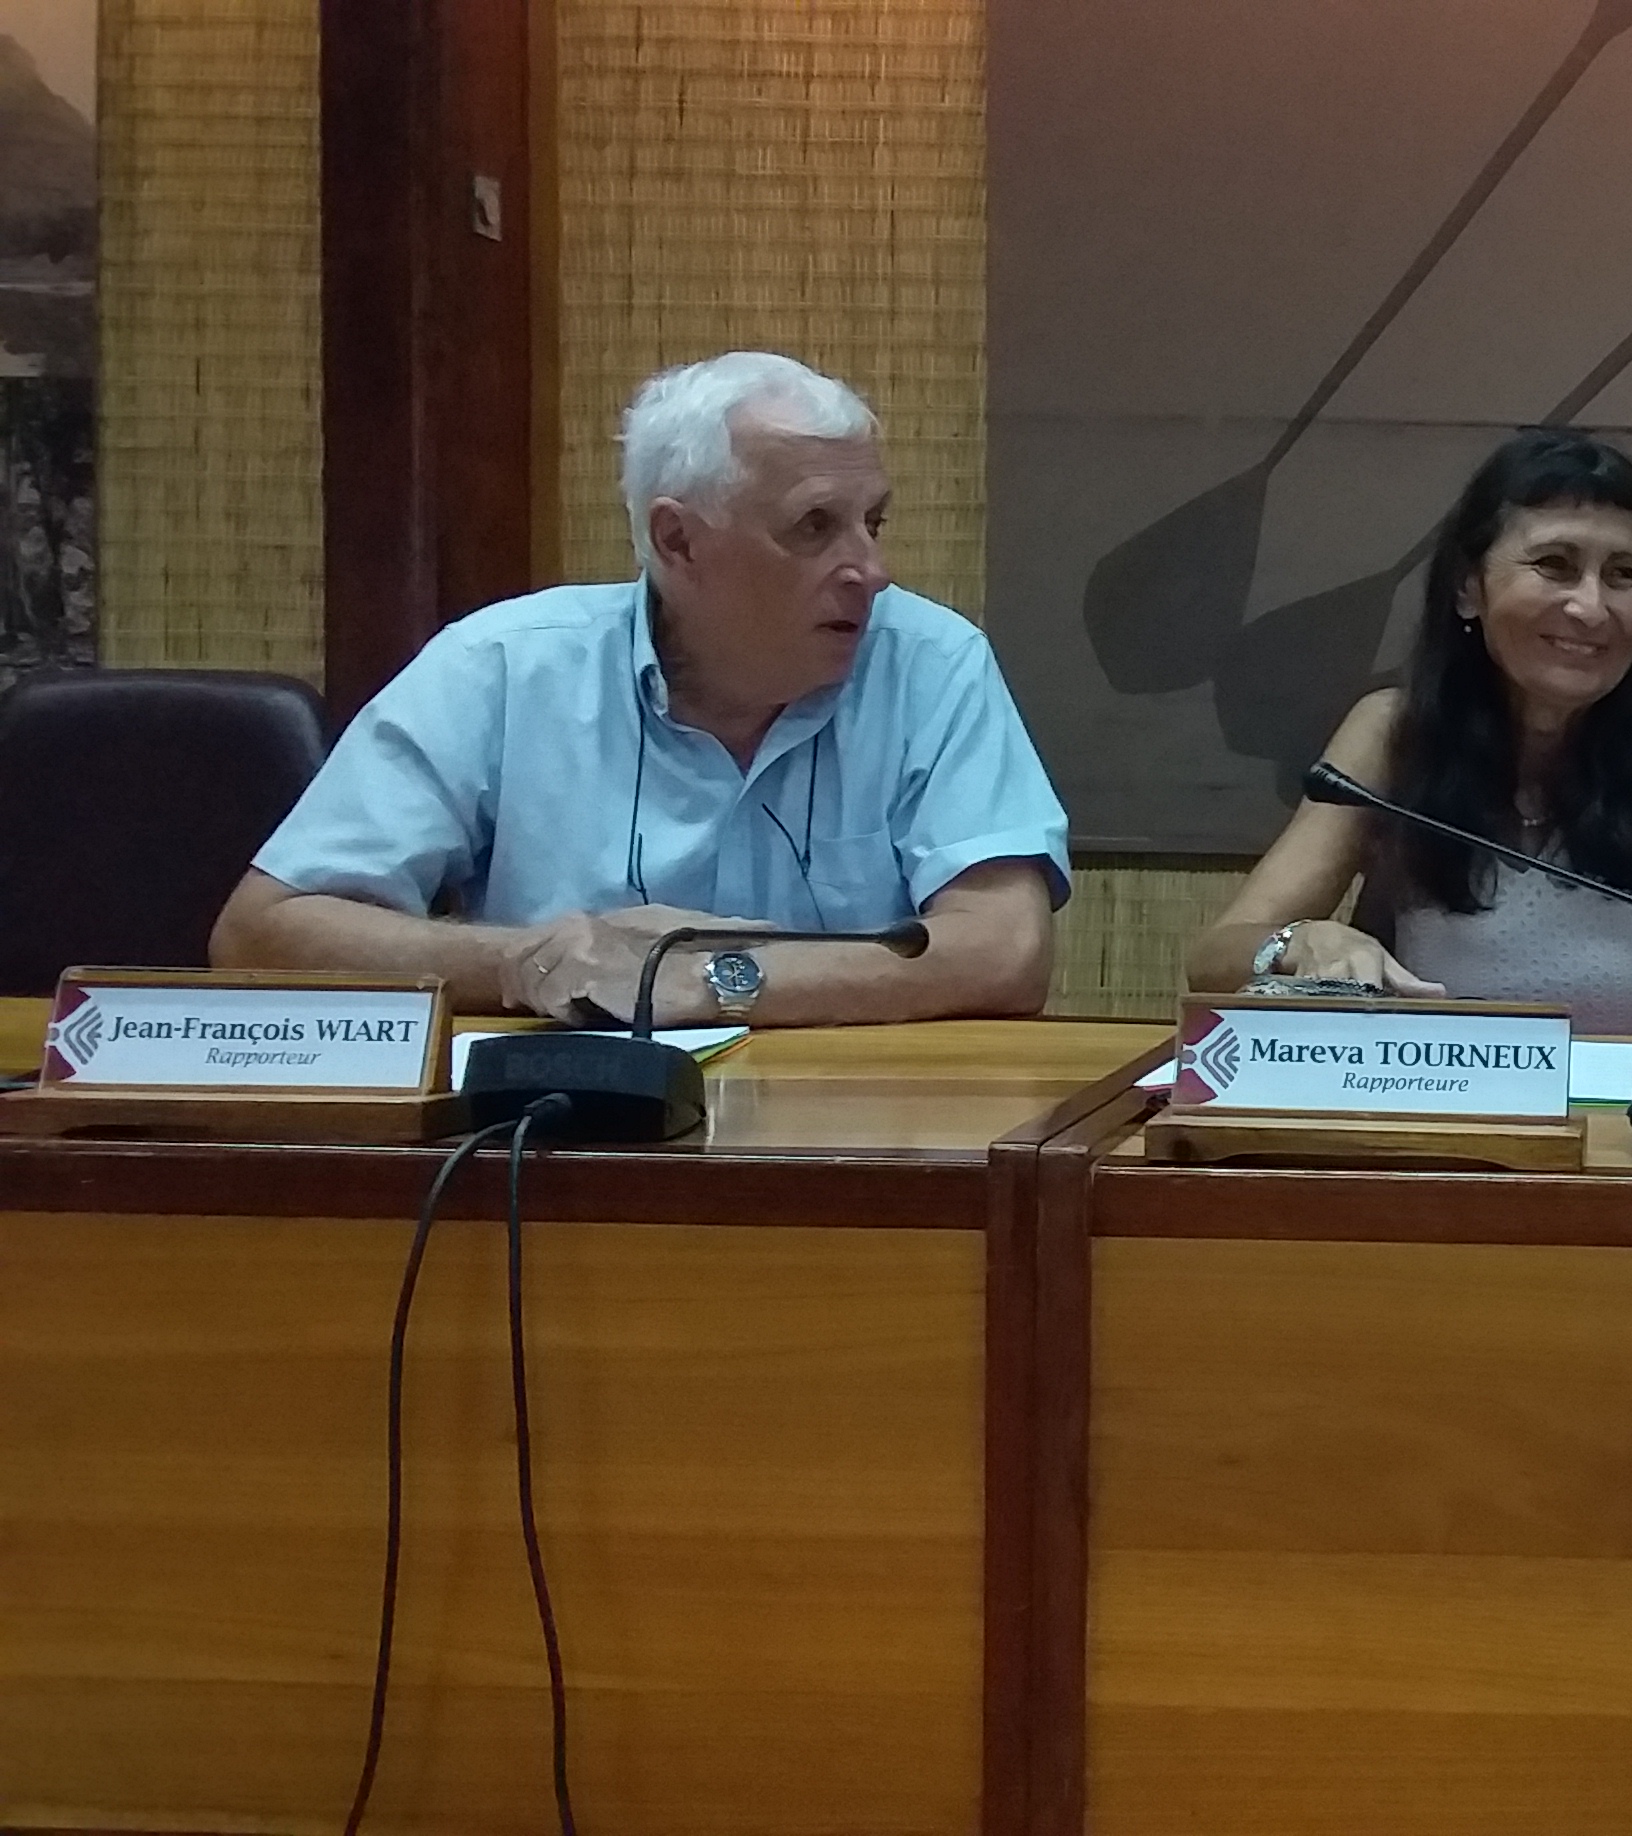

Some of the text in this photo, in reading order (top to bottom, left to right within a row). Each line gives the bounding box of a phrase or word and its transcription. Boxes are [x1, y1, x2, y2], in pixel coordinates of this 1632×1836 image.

[108, 1016, 419, 1045] Jean-François WIART
[205, 1047, 321, 1066] Rapporteur
[505, 1052, 622, 1081] BOSCH
[1249, 1038, 1557, 1070] Mareva TOURNEUX
[1342, 1072, 1469, 1093] Rapporteure
